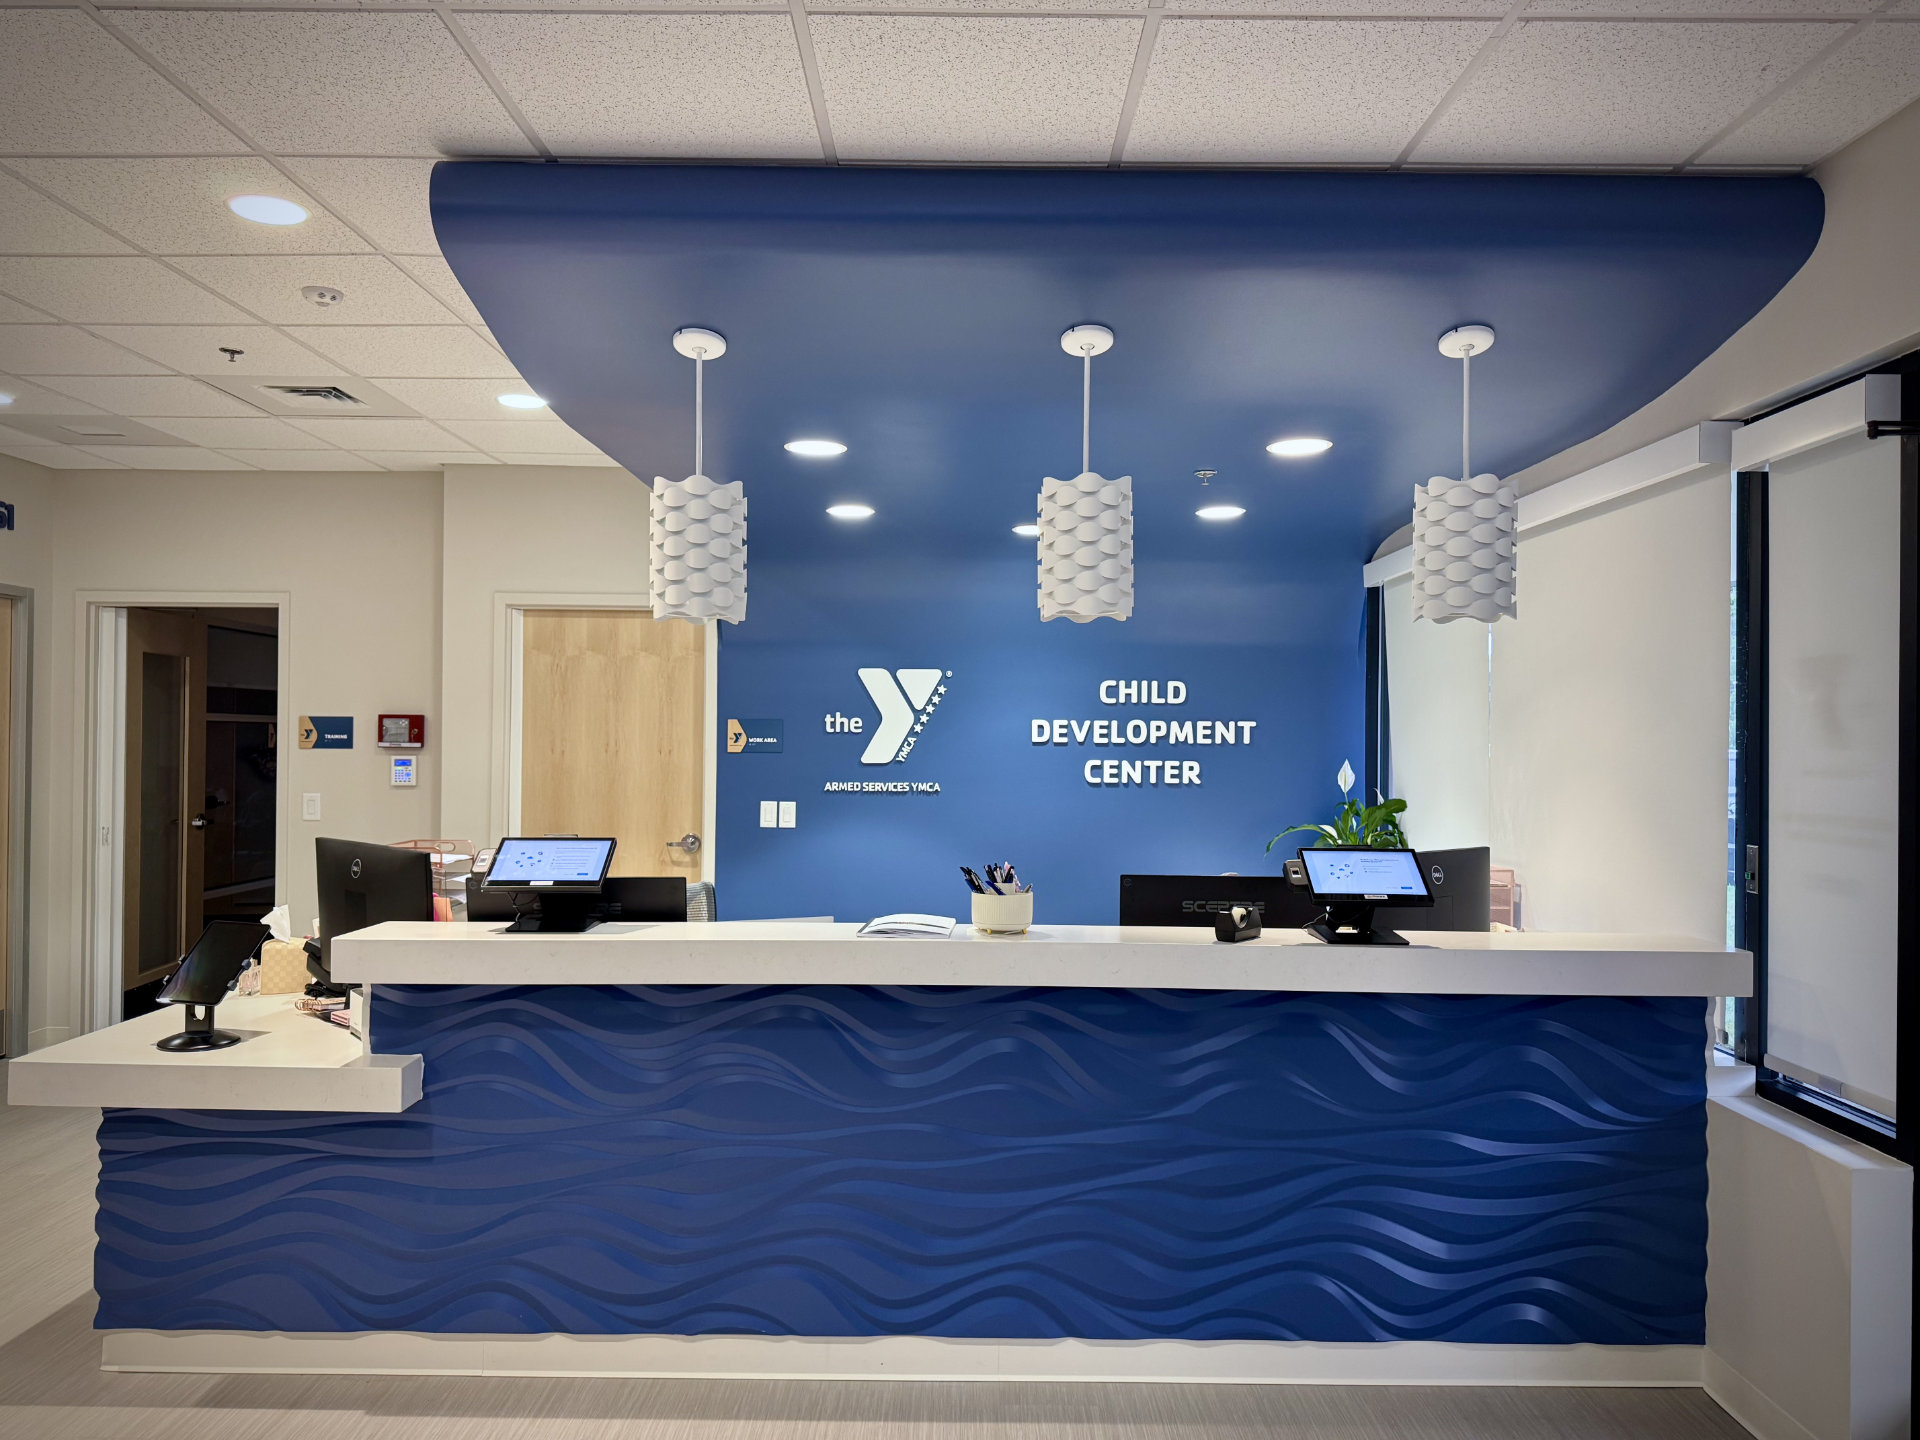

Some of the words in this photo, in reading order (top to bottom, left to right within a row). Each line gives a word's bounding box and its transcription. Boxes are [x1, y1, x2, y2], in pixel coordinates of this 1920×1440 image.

[1099, 679, 1187, 704] CHILD
[824, 711, 863, 733] the
[1031, 718, 1257, 745] DEVELOPMENT
[895, 736, 917, 762] YMCA
[1083, 759, 1202, 785] CENTER
[823, 781, 862, 792] ARMED
[863, 781, 910, 792] SERVICES
[911, 781, 941, 792] YMCA
